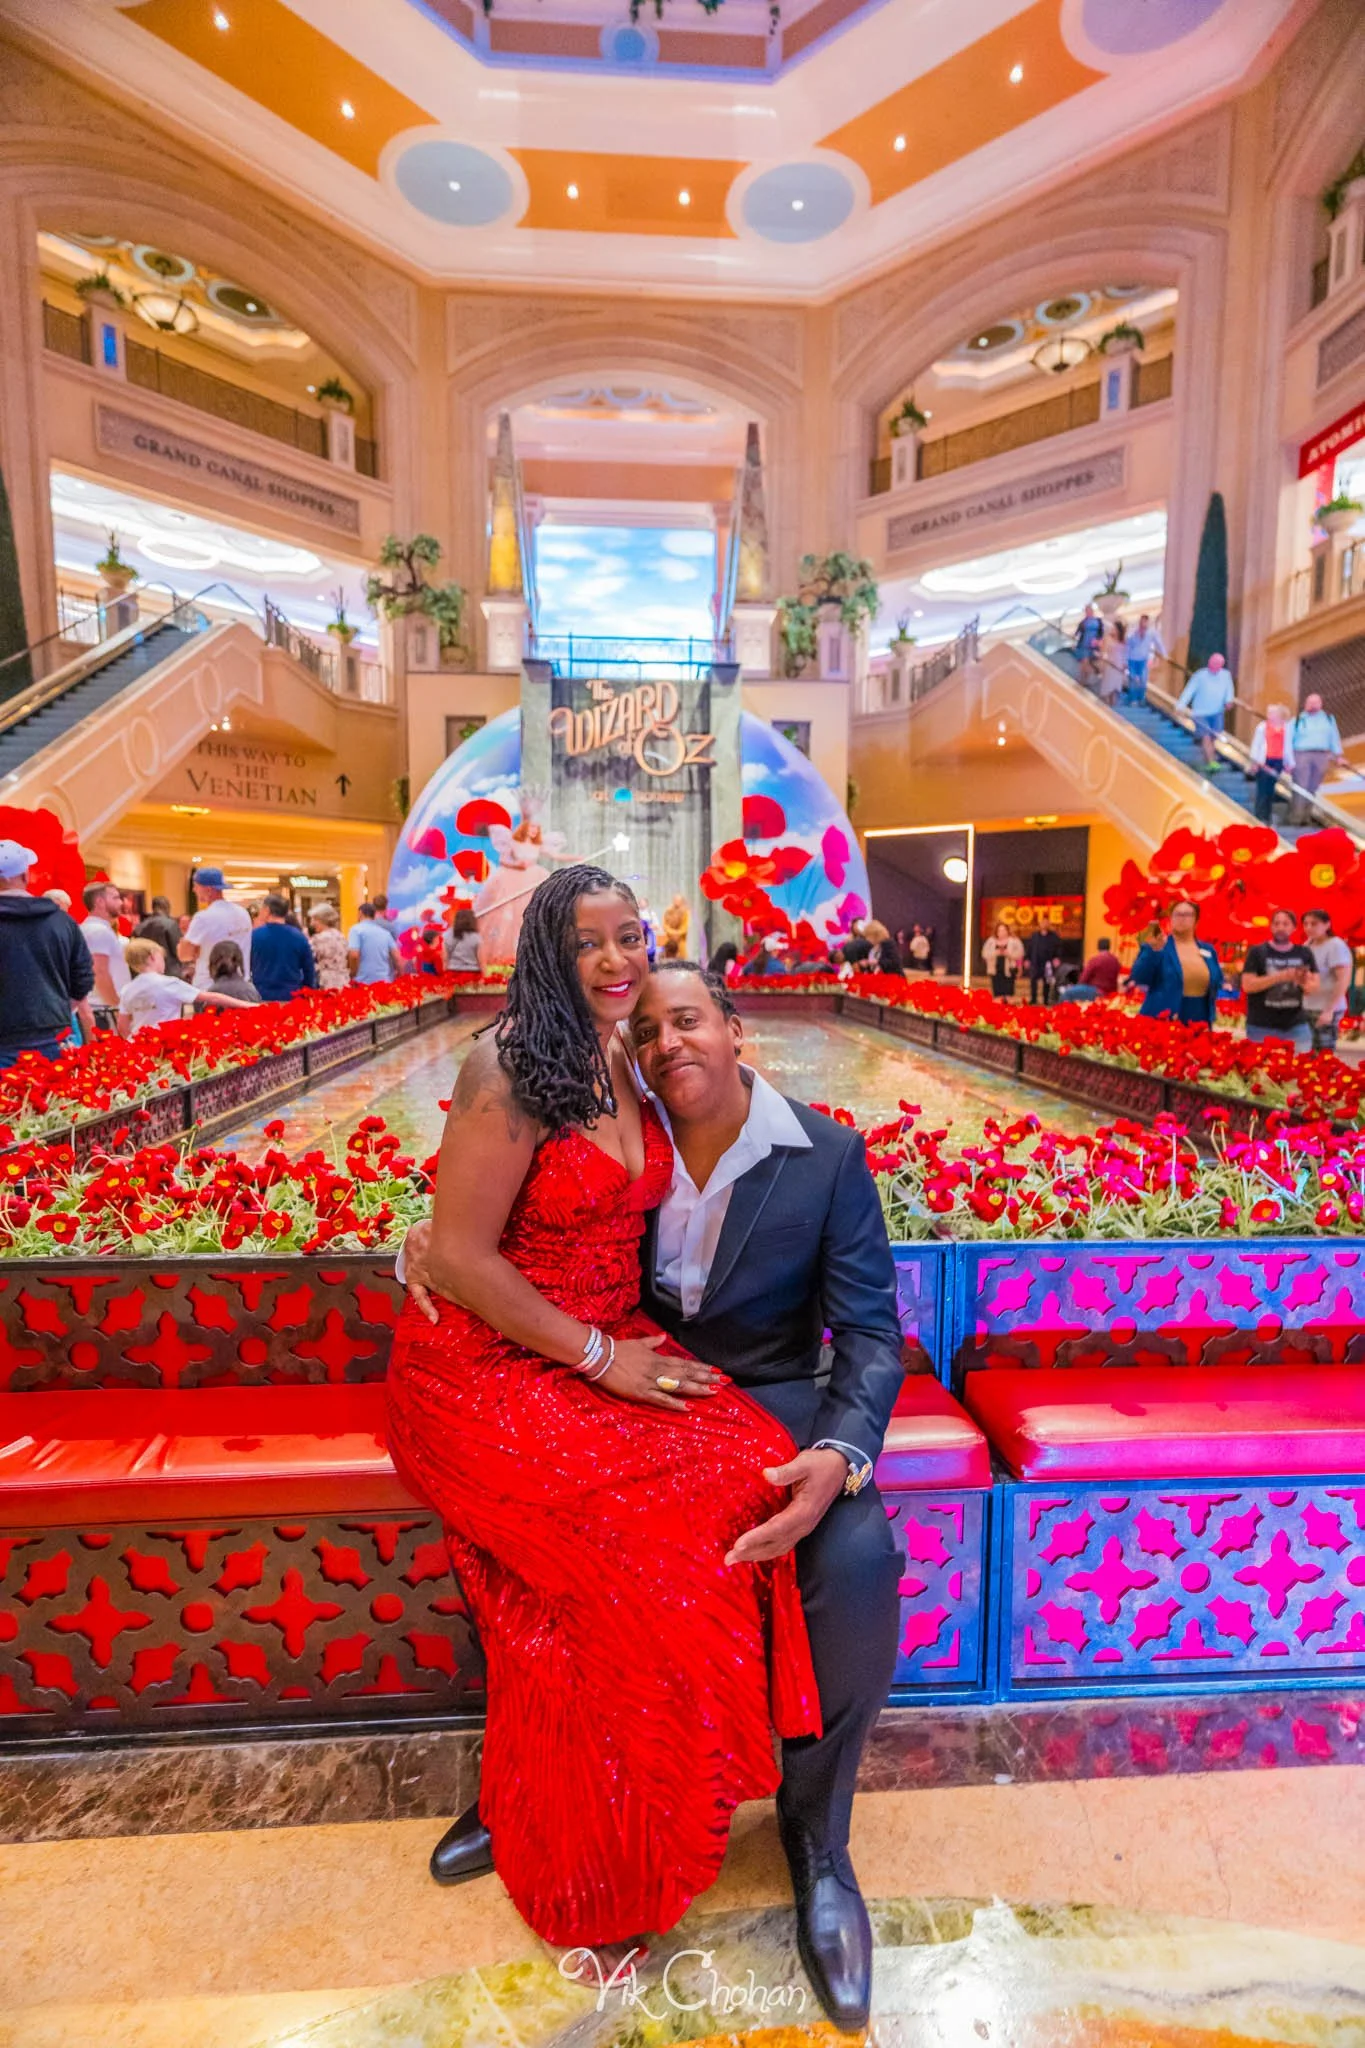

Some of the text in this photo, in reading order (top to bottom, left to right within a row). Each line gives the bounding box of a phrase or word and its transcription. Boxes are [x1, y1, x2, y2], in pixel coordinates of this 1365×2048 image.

[1307, 412, 1365, 464] ATOMI
[134, 434, 335, 516] GRAND CANAL SHOPPES
[911, 470, 1095, 534] GRAND CANAL SHOPPES
[585, 679, 614, 700] The
[549, 681, 679, 756] WIZARD
[198, 741, 306, 768] THIS WAY TO
[234, 763, 269, 779] THE
[634, 725, 716, 776] Oz
[187, 768, 317, 807] VENETIAN
[999, 905, 1064, 925] COTE
